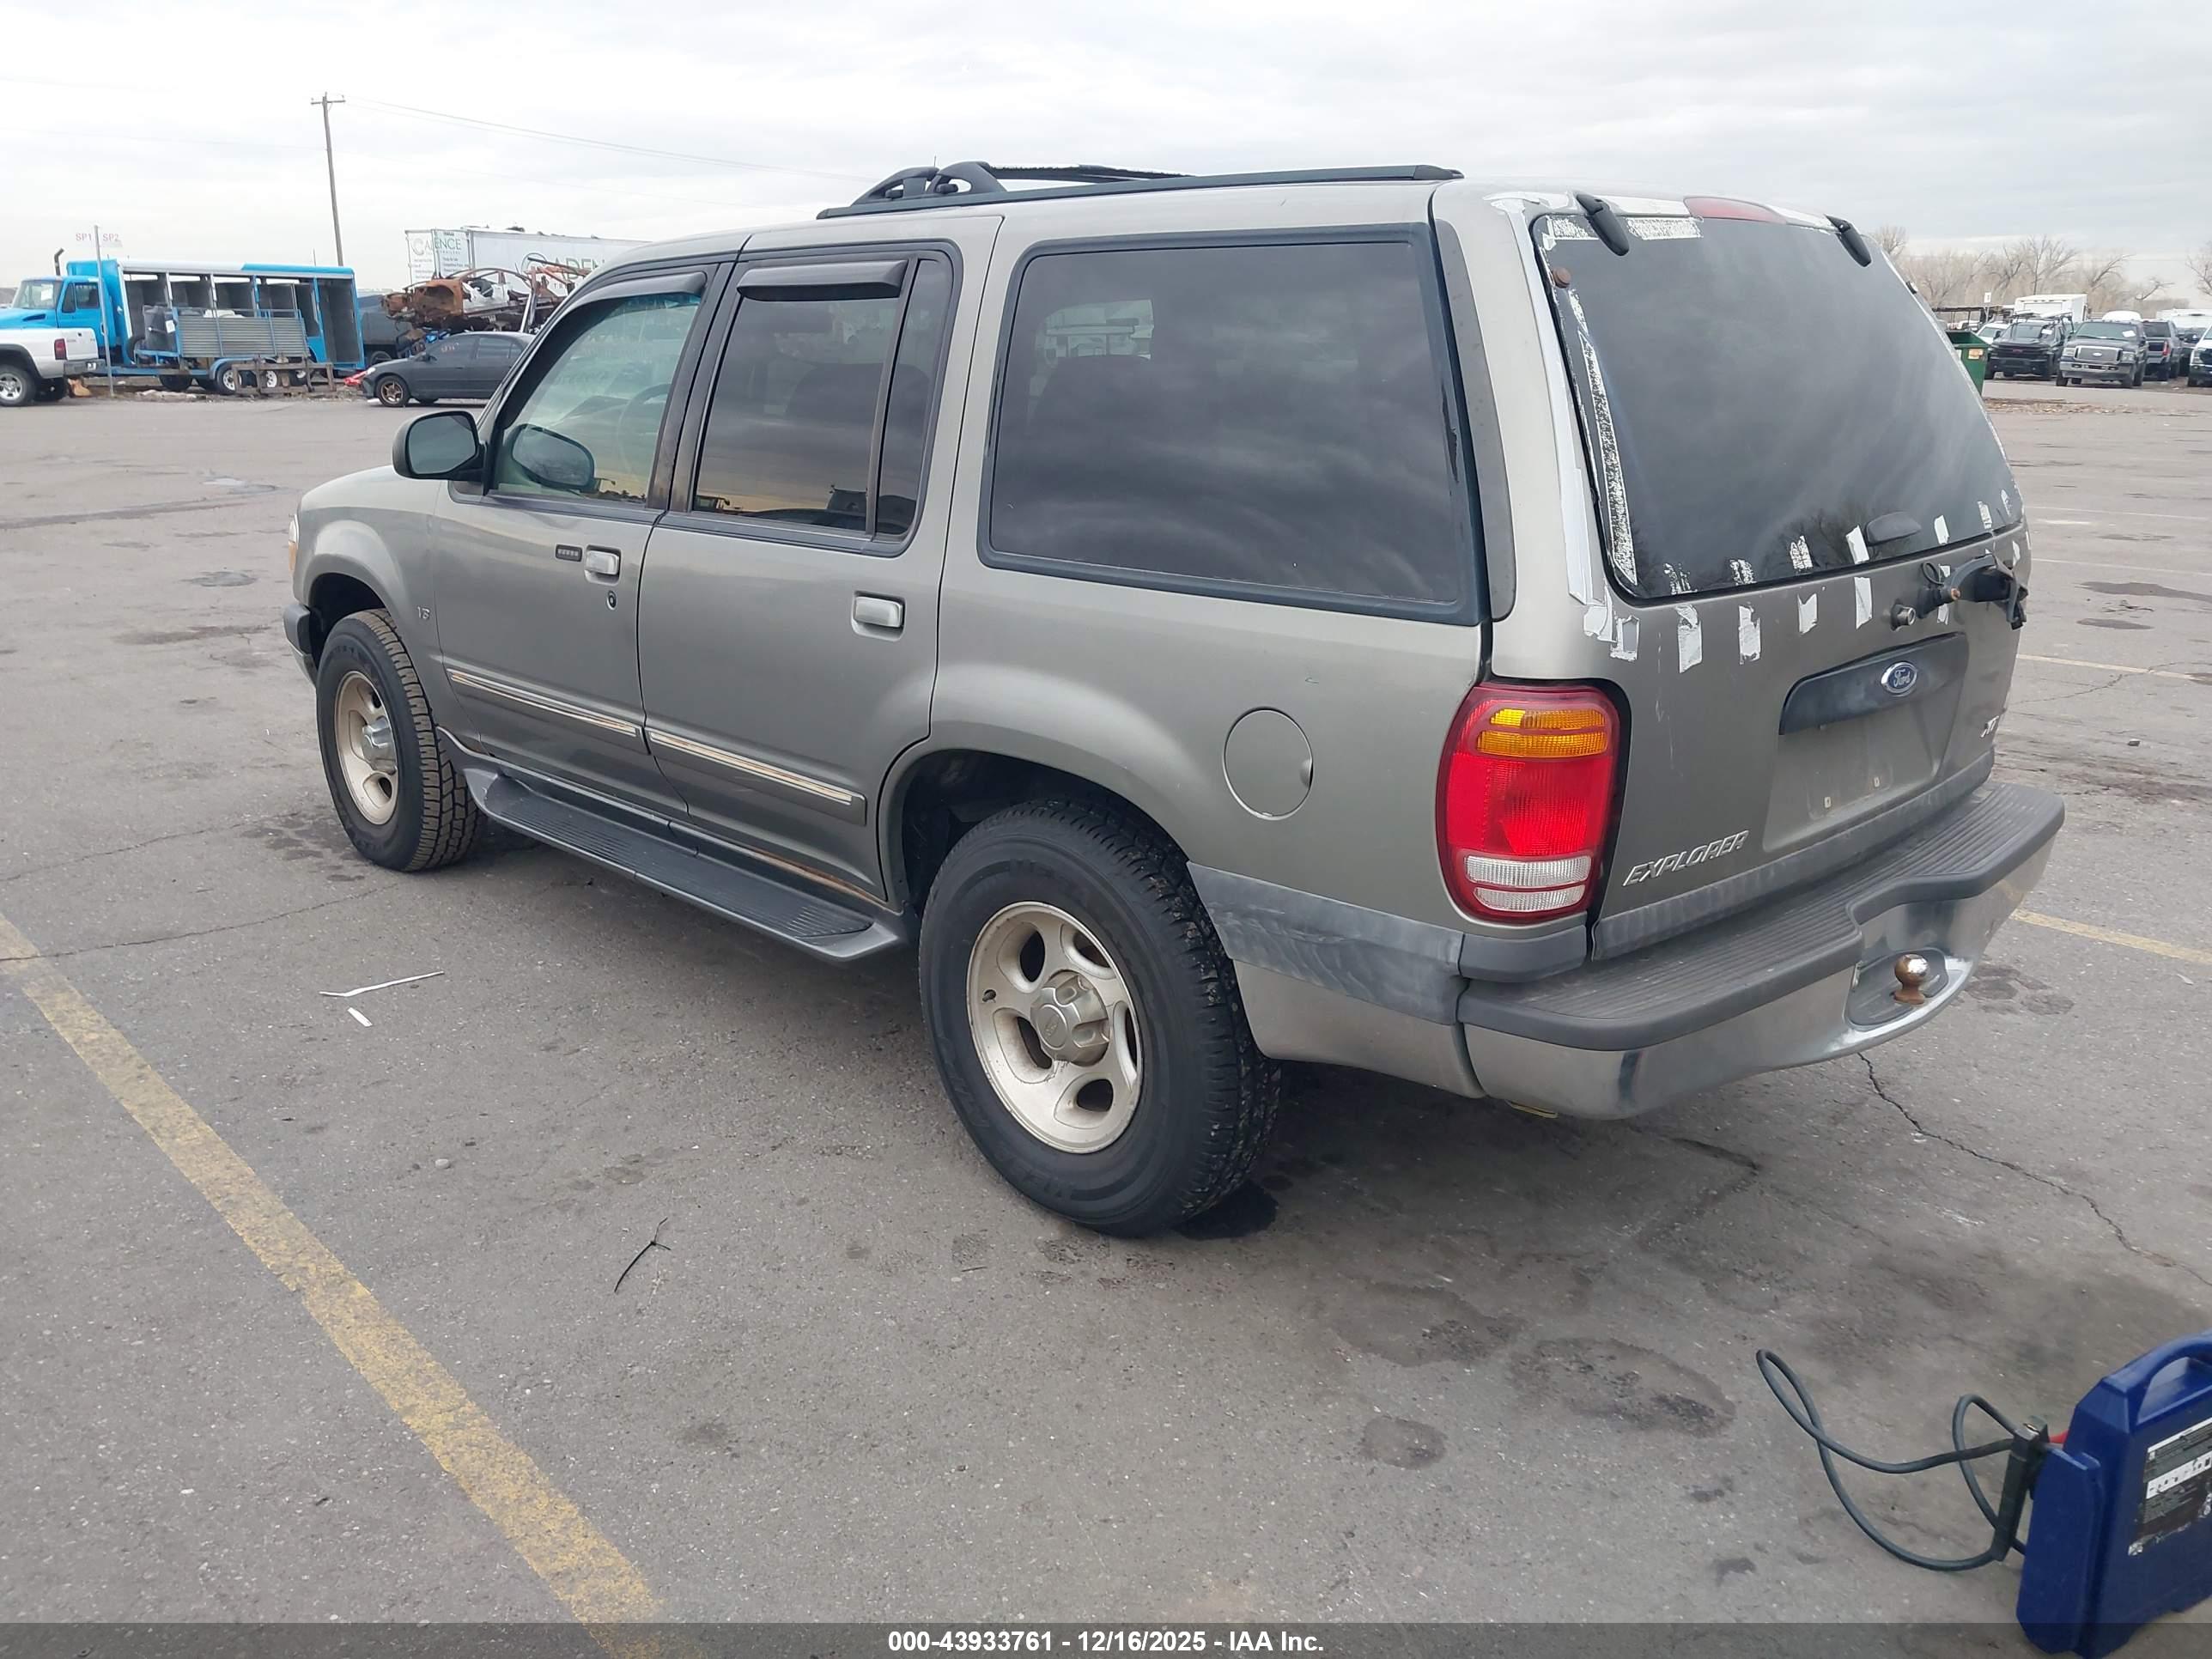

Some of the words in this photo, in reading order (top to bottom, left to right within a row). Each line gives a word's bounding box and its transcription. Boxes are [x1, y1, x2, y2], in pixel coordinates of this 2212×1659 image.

[76, 233, 91, 241] SP1
[102, 233, 119, 241] SP2
[1623, 830, 1749, 887] EXPLORER
